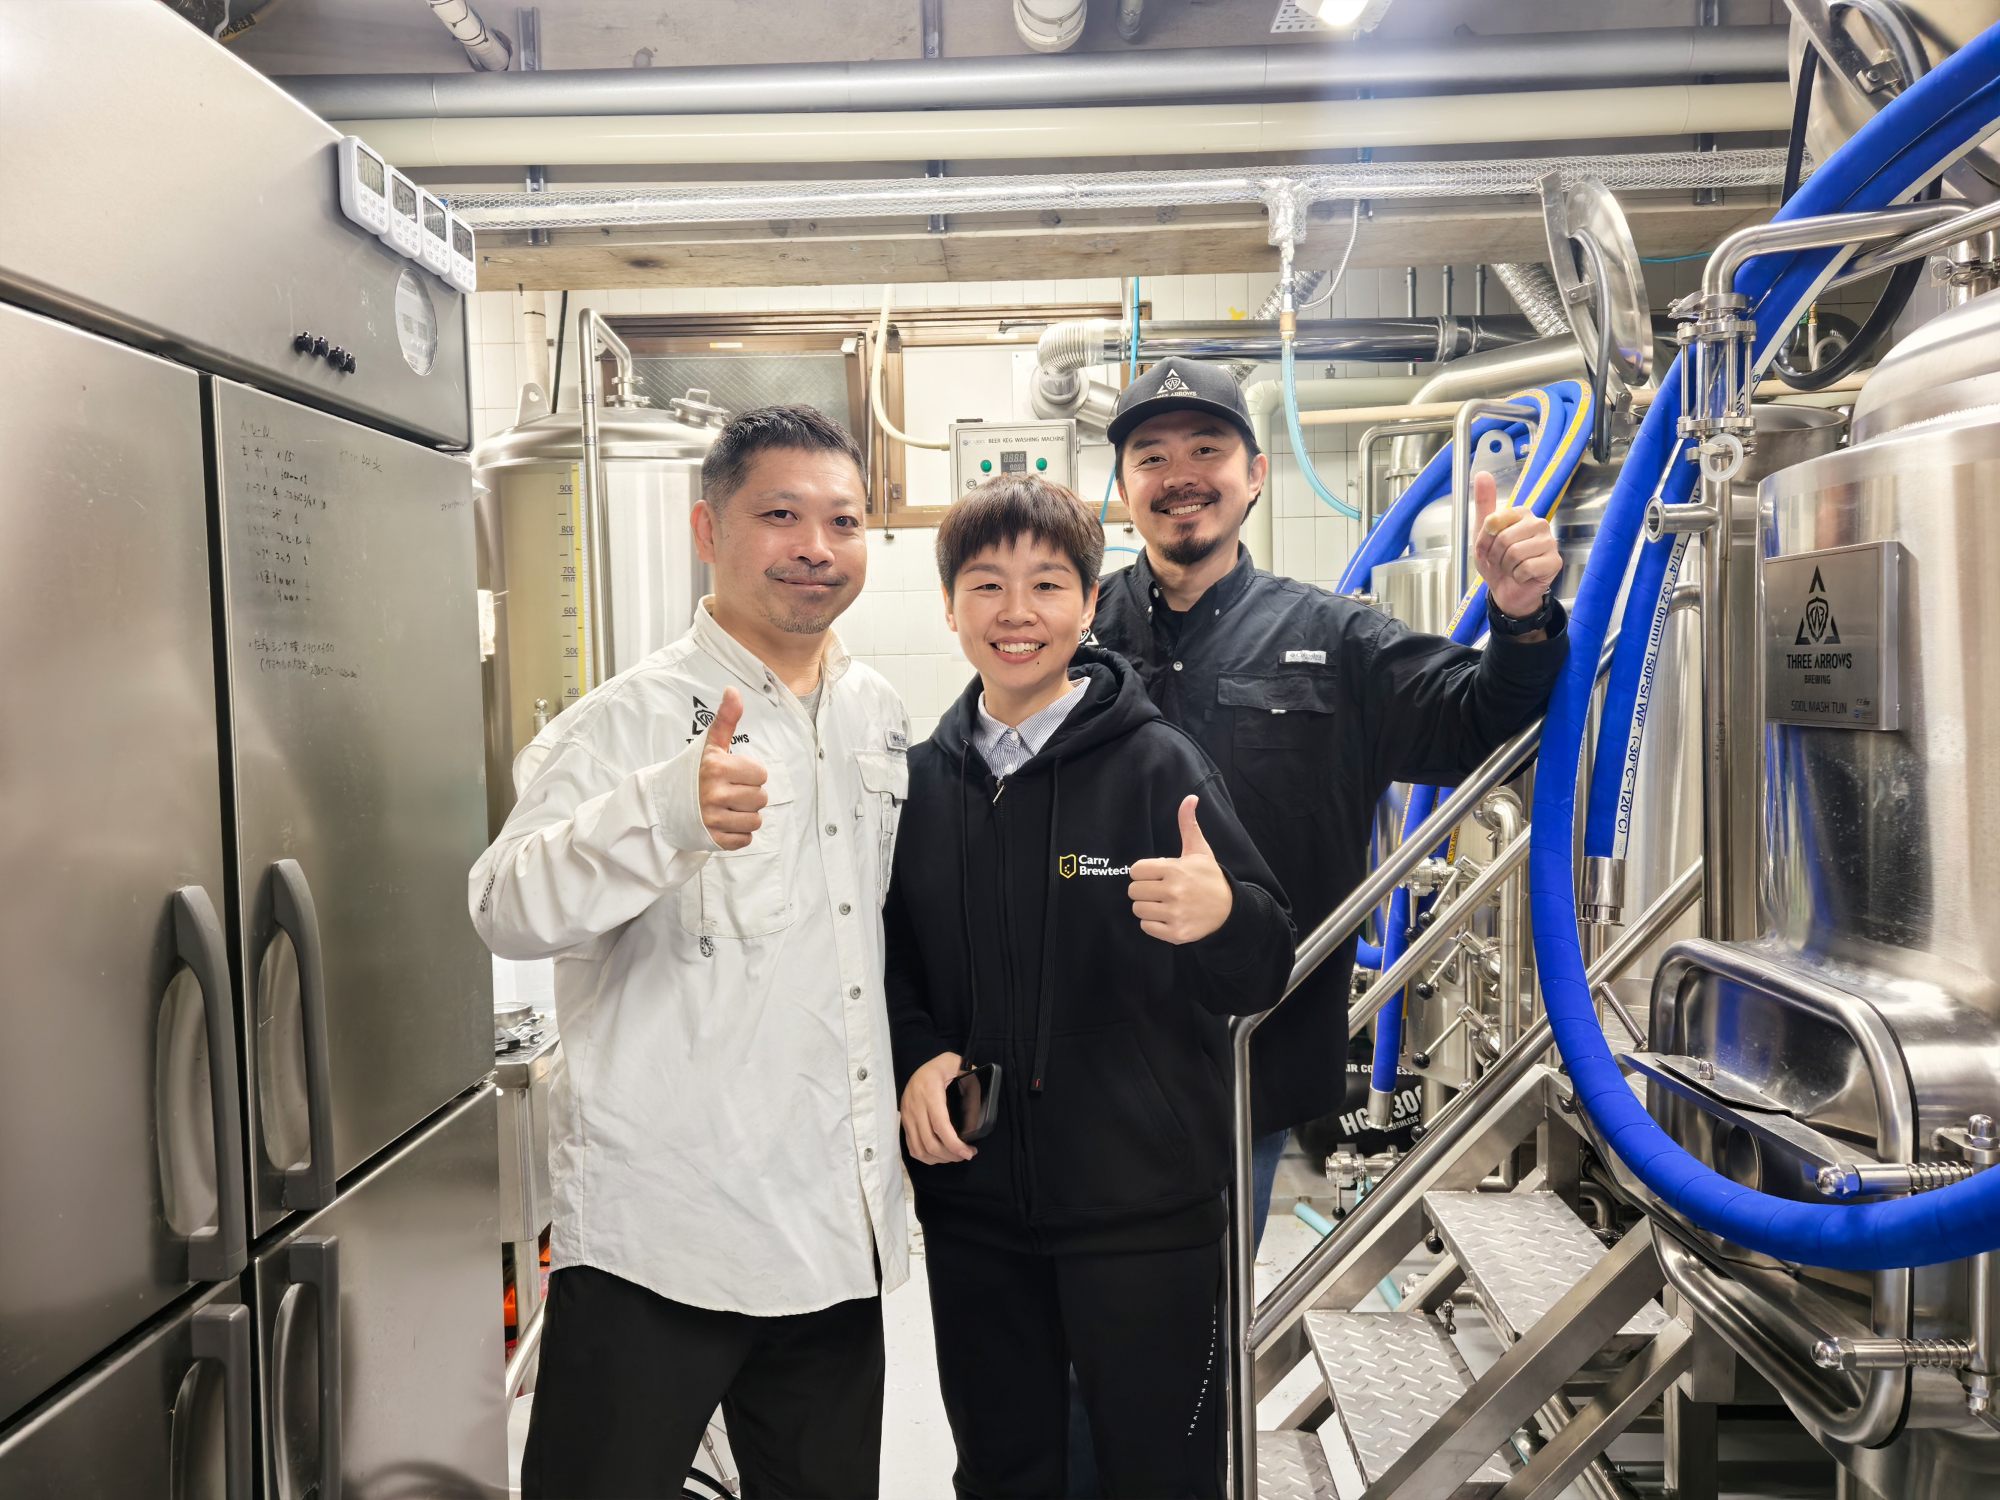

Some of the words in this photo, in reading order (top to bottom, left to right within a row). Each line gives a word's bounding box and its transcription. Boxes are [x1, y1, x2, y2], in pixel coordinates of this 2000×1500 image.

[1786, 654, 1812, 669] THREE
[1814, 653, 1852, 670] ARROWS
[1804, 674, 1831, 685] BREWING
[1809, 700, 1830, 713] MASH
[1832, 701, 1848, 714] TUN
[1078, 854, 1110, 868] Carry
[1079, 865, 1131, 876] Brewtech
[1345, 1063, 1358, 1073] IR
